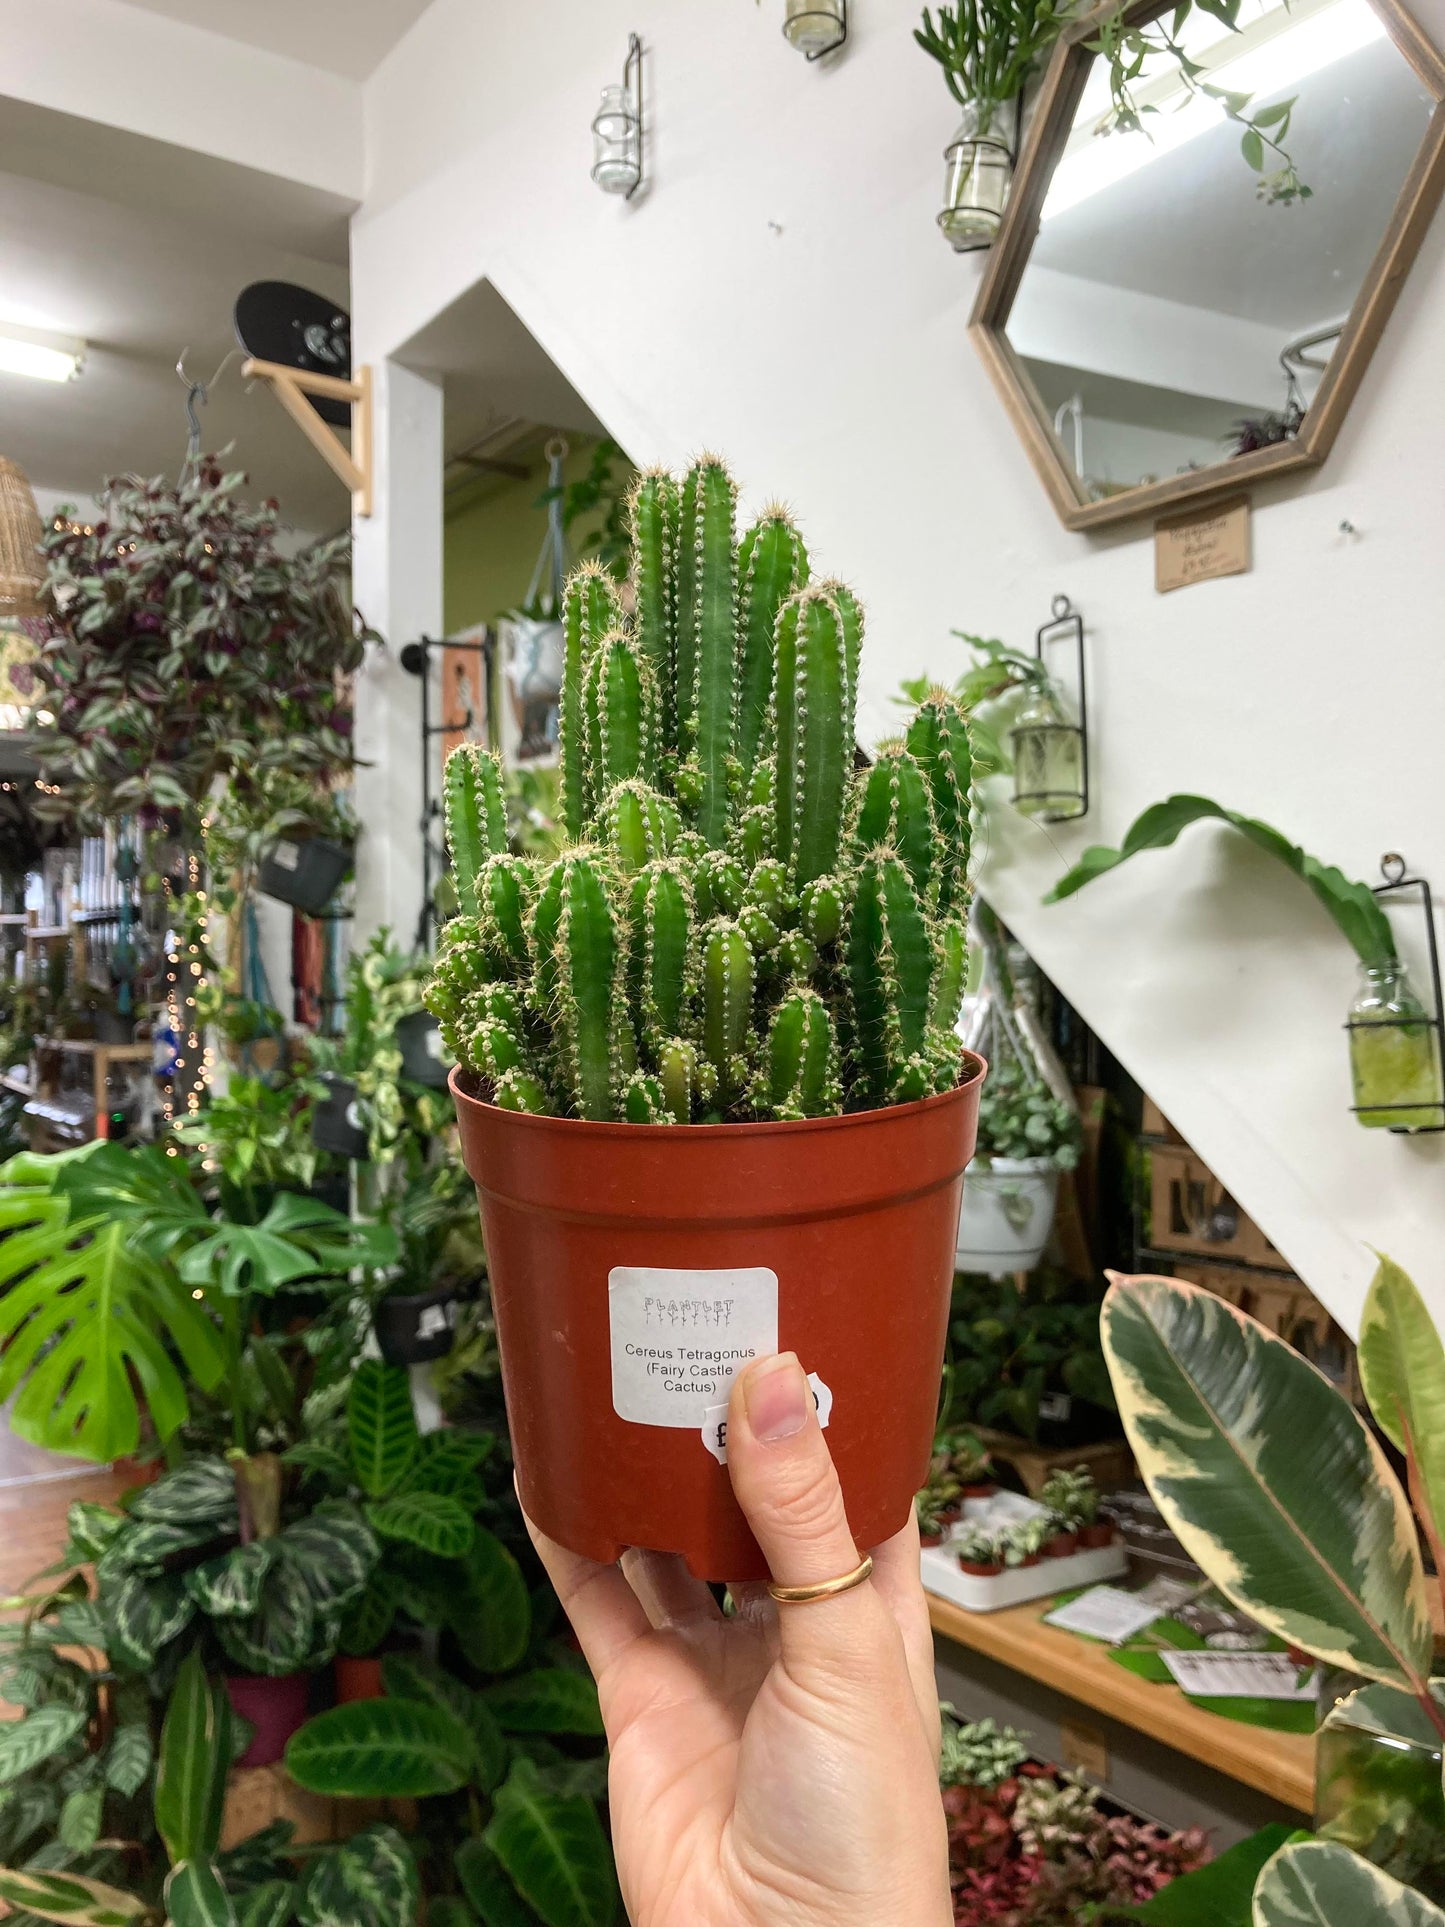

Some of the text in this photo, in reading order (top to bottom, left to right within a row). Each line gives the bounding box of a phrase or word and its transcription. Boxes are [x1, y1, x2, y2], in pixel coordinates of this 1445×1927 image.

[643, 1297, 734, 1321] PLANTLET
[625, 1343, 756, 1362] Cereus Tetragonus
[646, 1362, 733, 1377] (Fairy Castle
[663, 1380, 717, 1395] Cactus)
